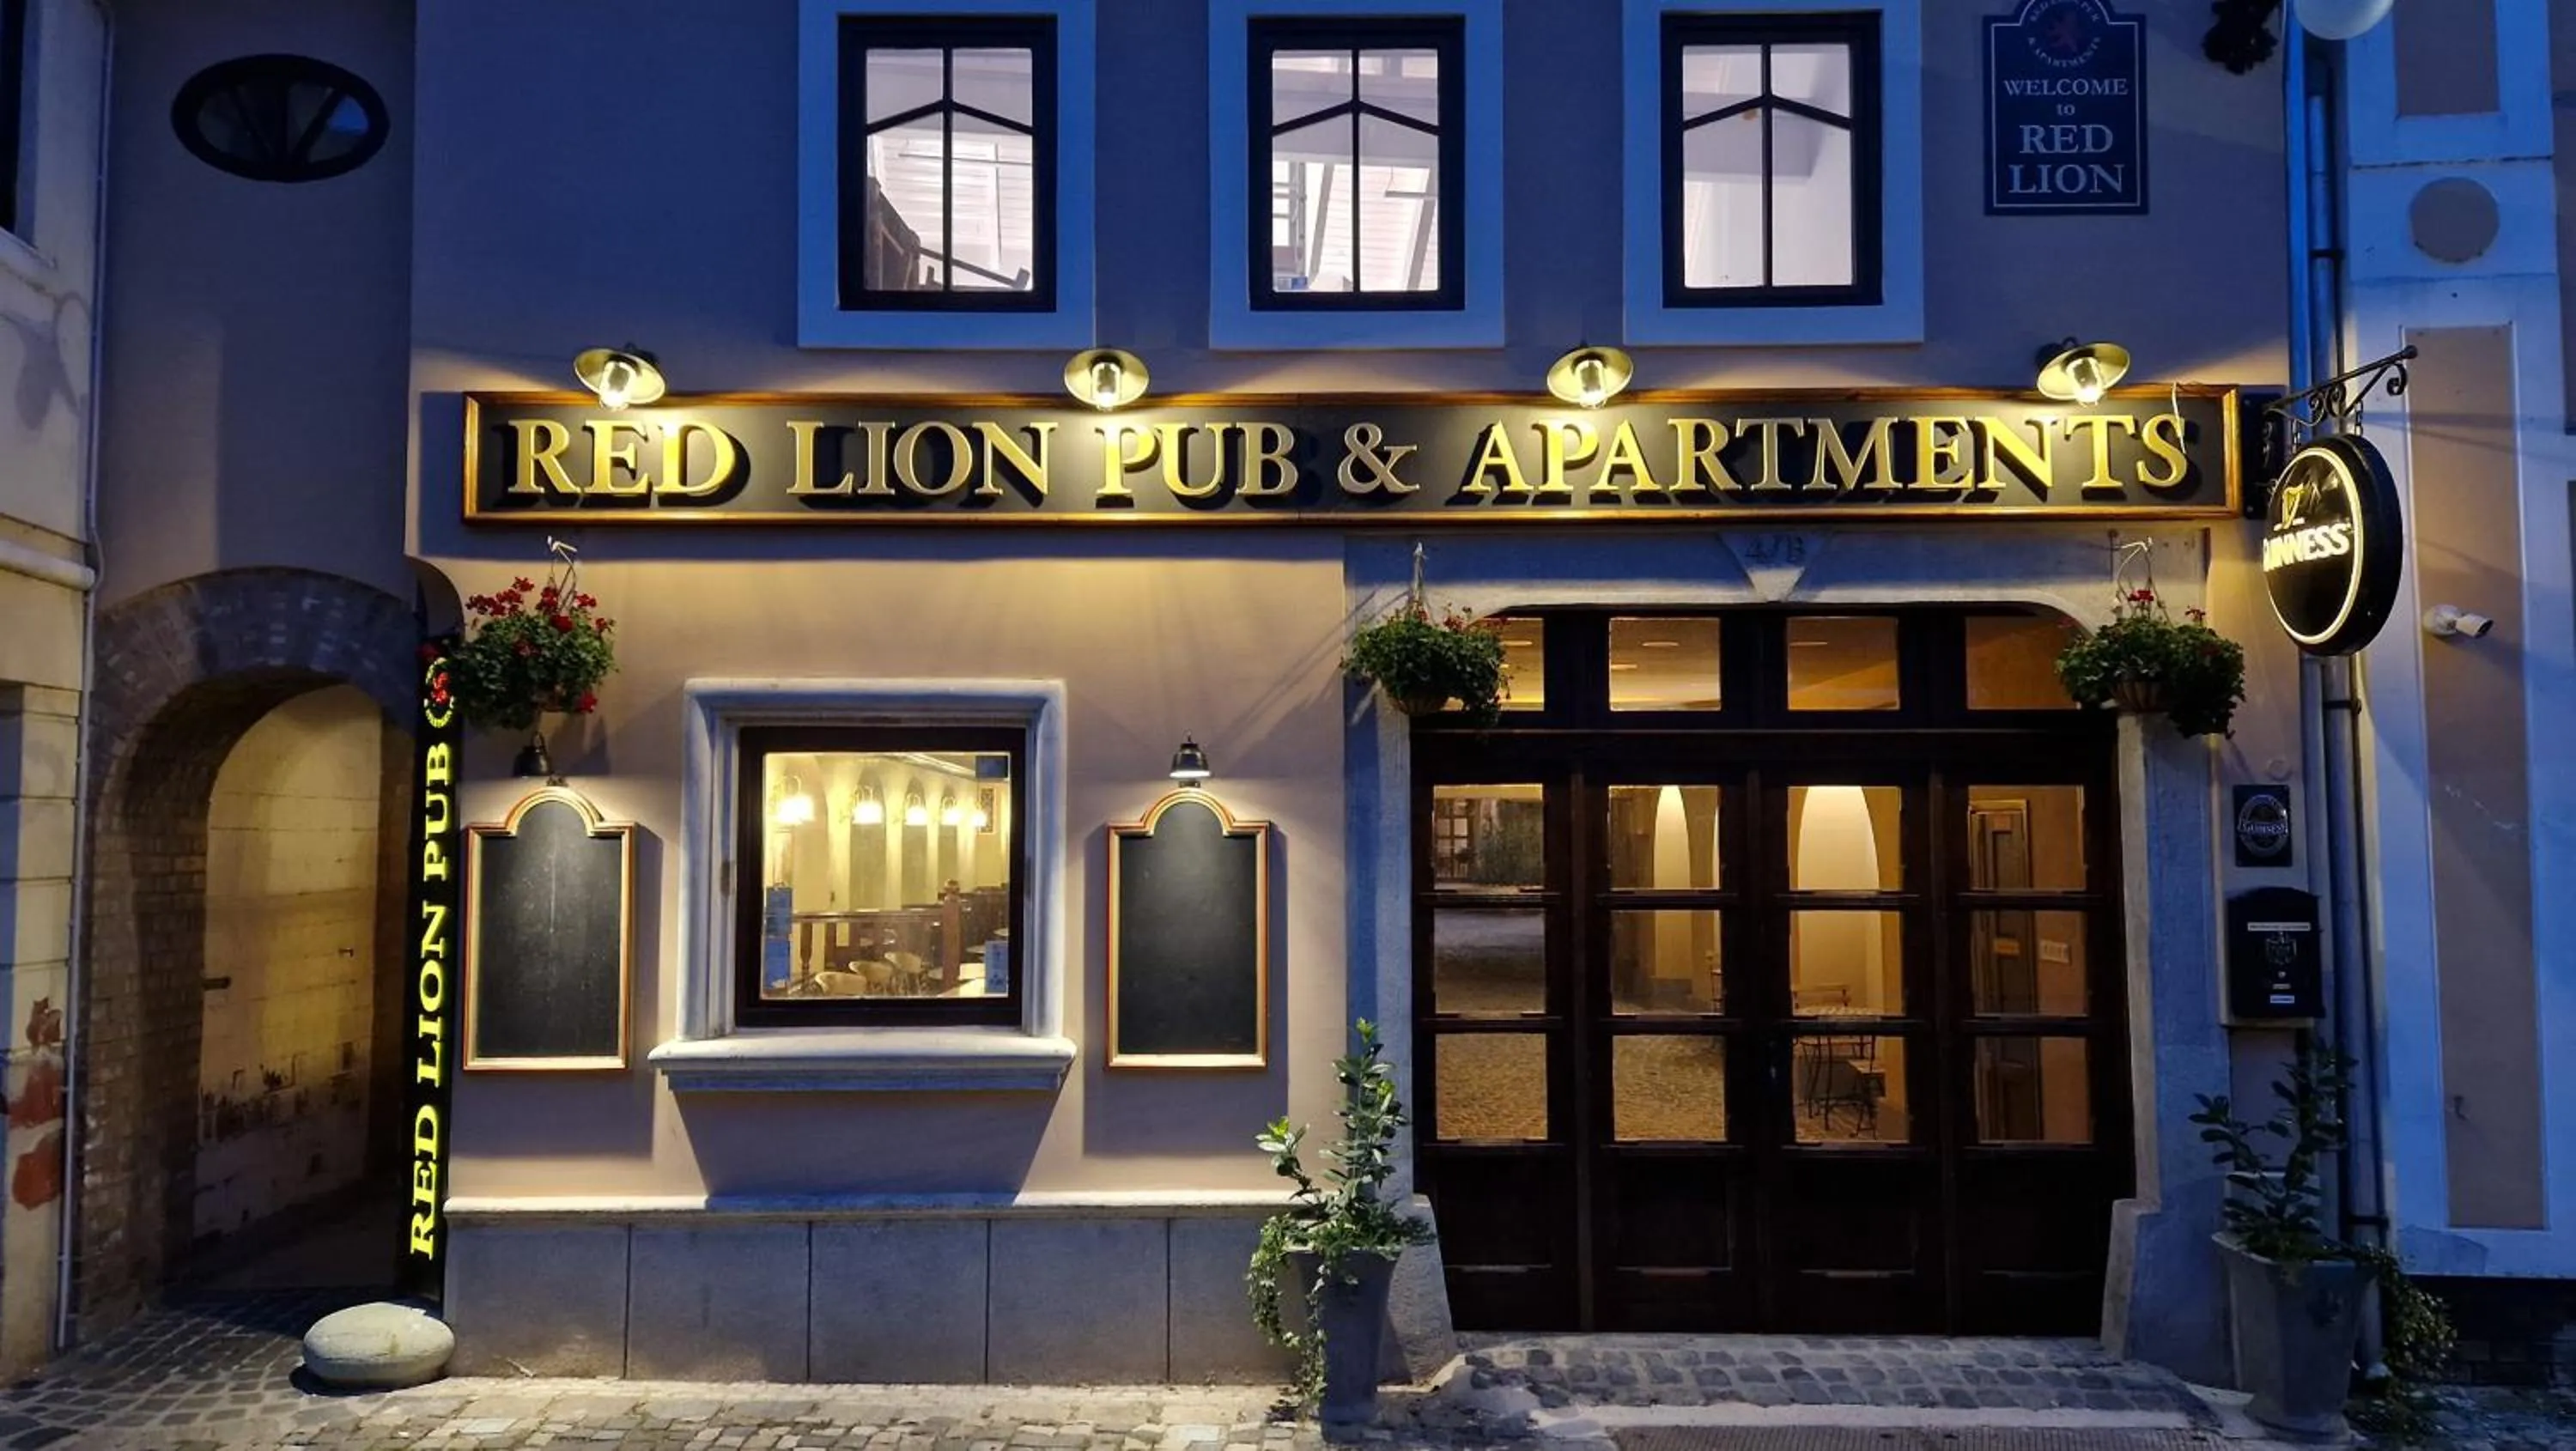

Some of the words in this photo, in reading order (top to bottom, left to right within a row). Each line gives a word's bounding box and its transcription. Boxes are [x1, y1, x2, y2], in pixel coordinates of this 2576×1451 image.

[2003, 78, 2129, 96] WELCOME
[2057, 104, 2075, 116] to
[2019, 124, 2114, 154] RED
[2008, 163, 2125, 194] LION
[507, 419, 736, 497] RED
[786, 421, 1059, 495] LION
[1095, 421, 1299, 496] PUB
[1337, 422, 1420, 495] &
[1461, 414, 2188, 492] APARTMENTS
[423, 742, 450, 882] PUB
[416, 901, 447, 1088] LION
[410, 1104, 438, 1260] RED
